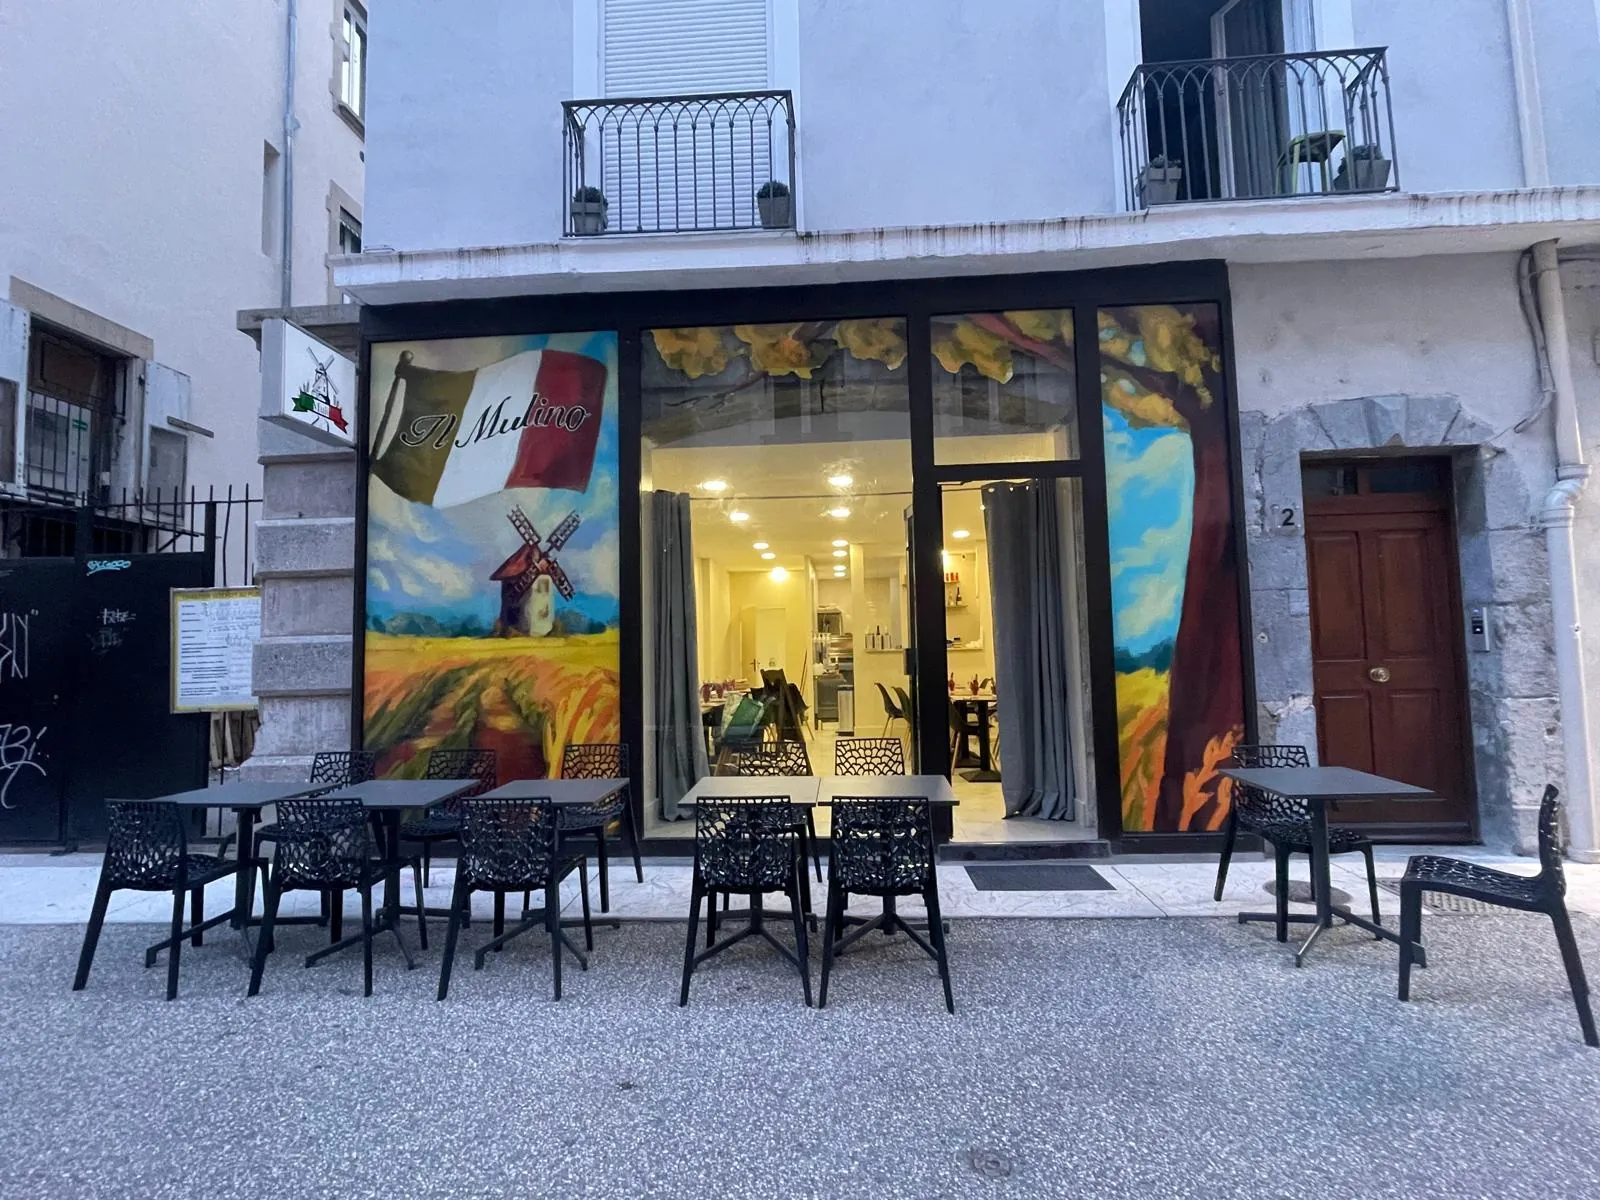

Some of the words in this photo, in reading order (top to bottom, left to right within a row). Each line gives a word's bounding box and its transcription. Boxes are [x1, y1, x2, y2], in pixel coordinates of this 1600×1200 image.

[400, 413, 458, 450] Il
[454, 393, 592, 449] Mulino
[1281, 508, 1295, 527] 2
